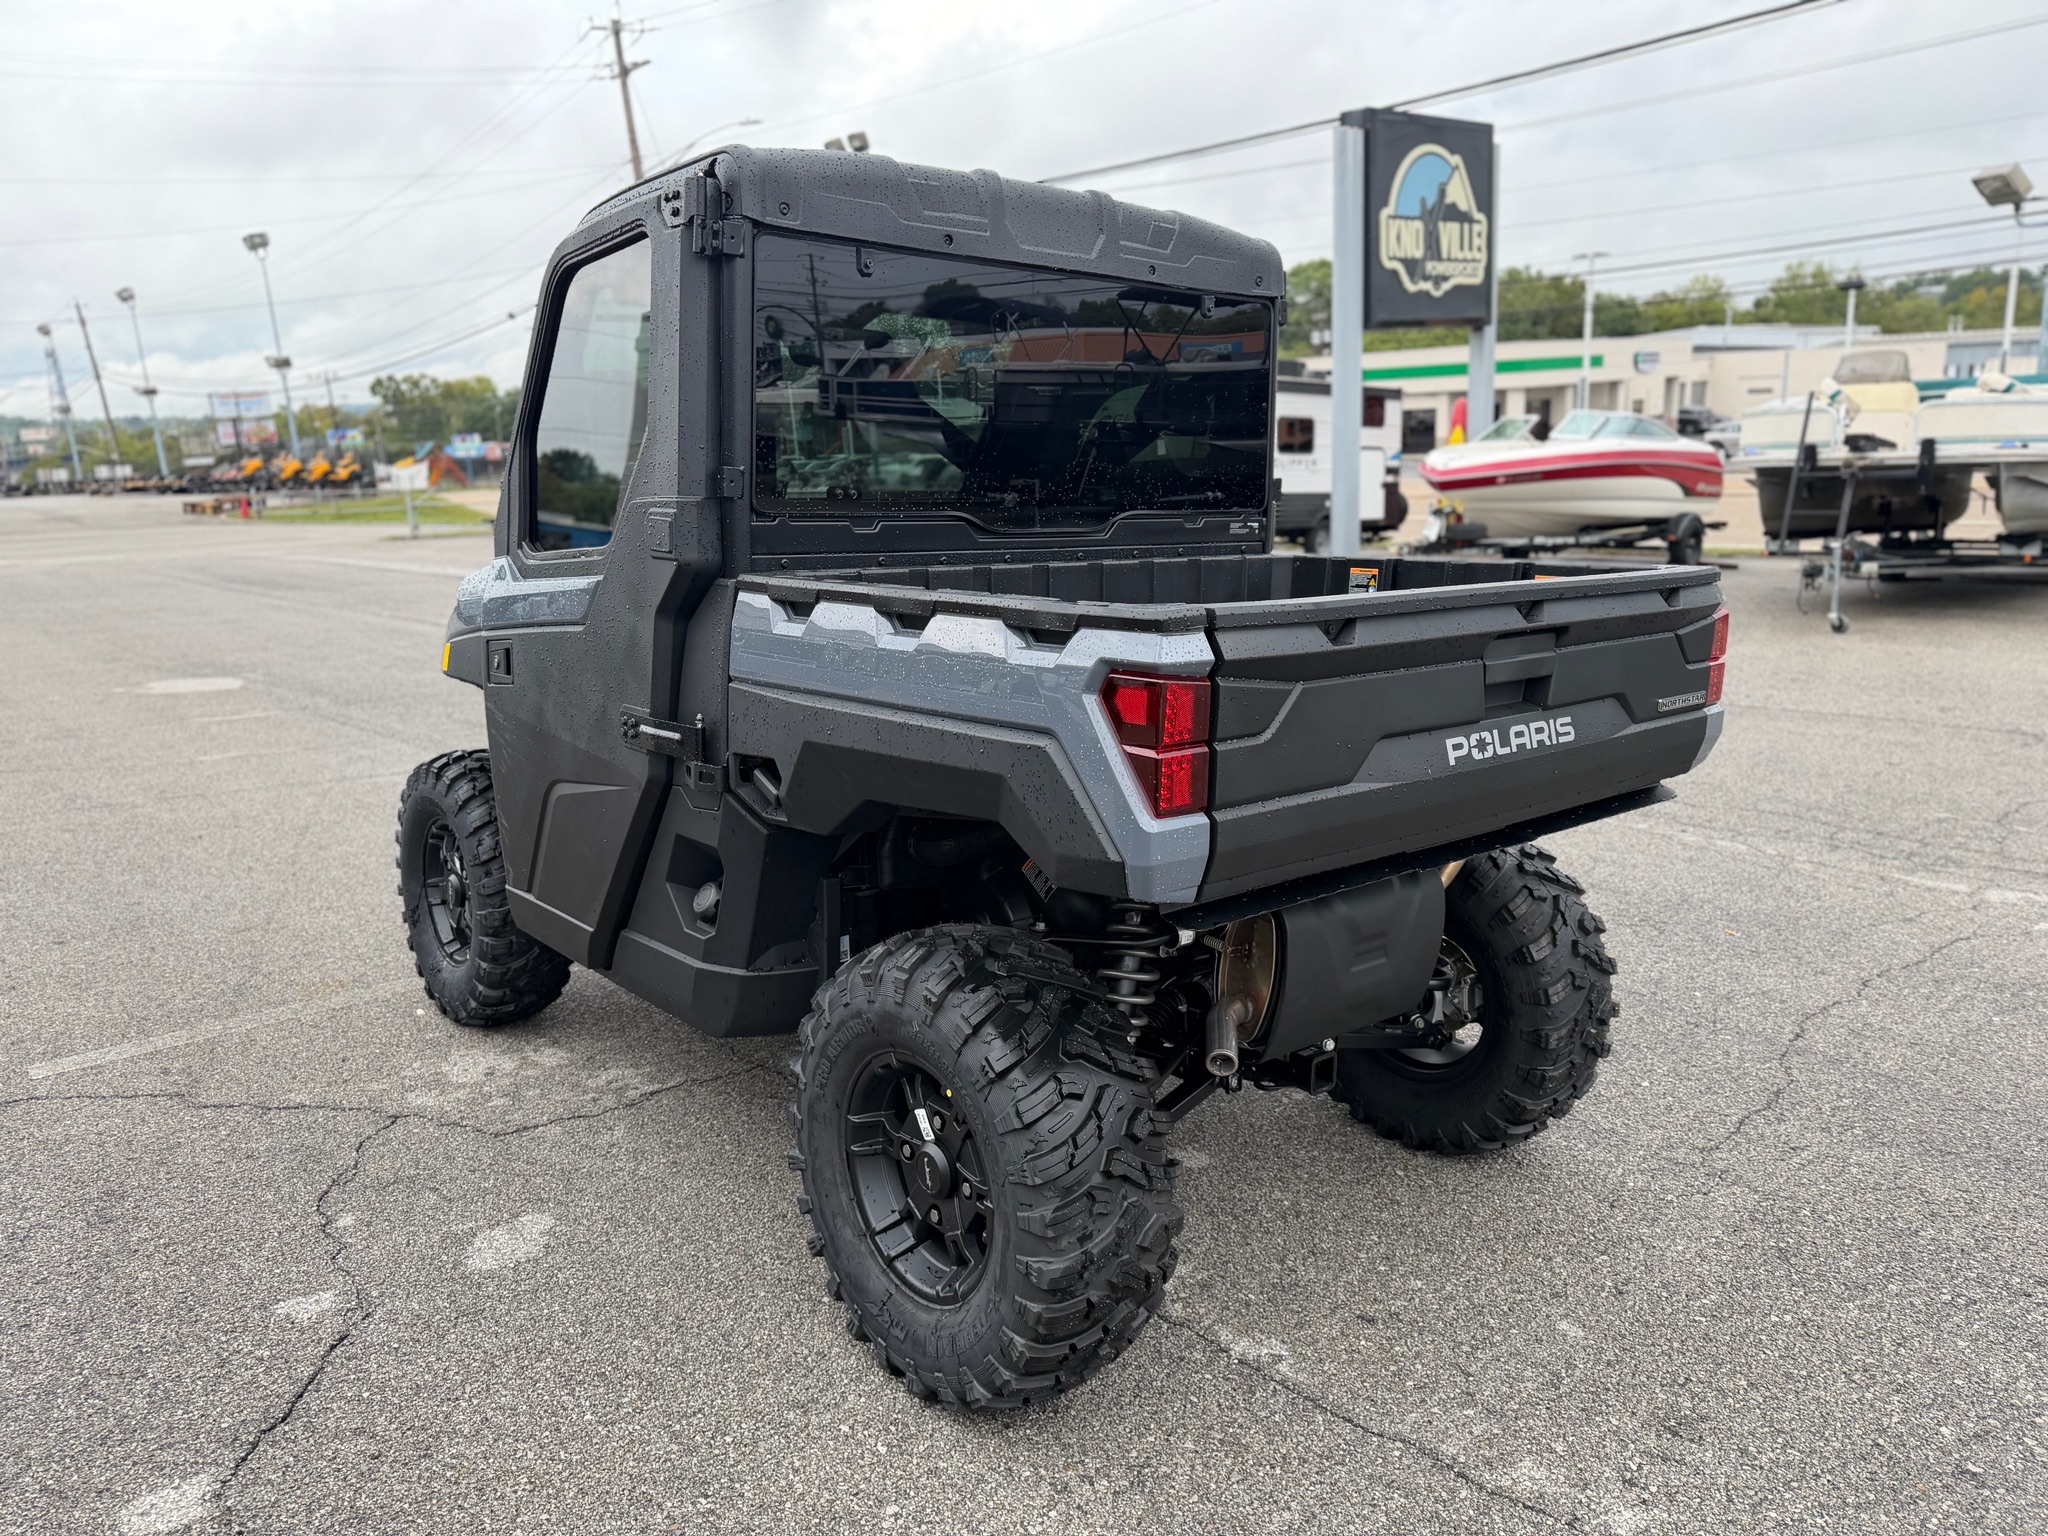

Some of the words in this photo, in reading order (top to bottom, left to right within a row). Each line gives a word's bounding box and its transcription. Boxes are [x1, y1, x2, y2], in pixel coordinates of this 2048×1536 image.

[1662, 693, 1706, 709] NORTHSTAR
[1445, 716, 1576, 766] POLARIS
[814, 1058, 832, 1098] PRO
[827, 1019, 868, 1063] ARMOR
